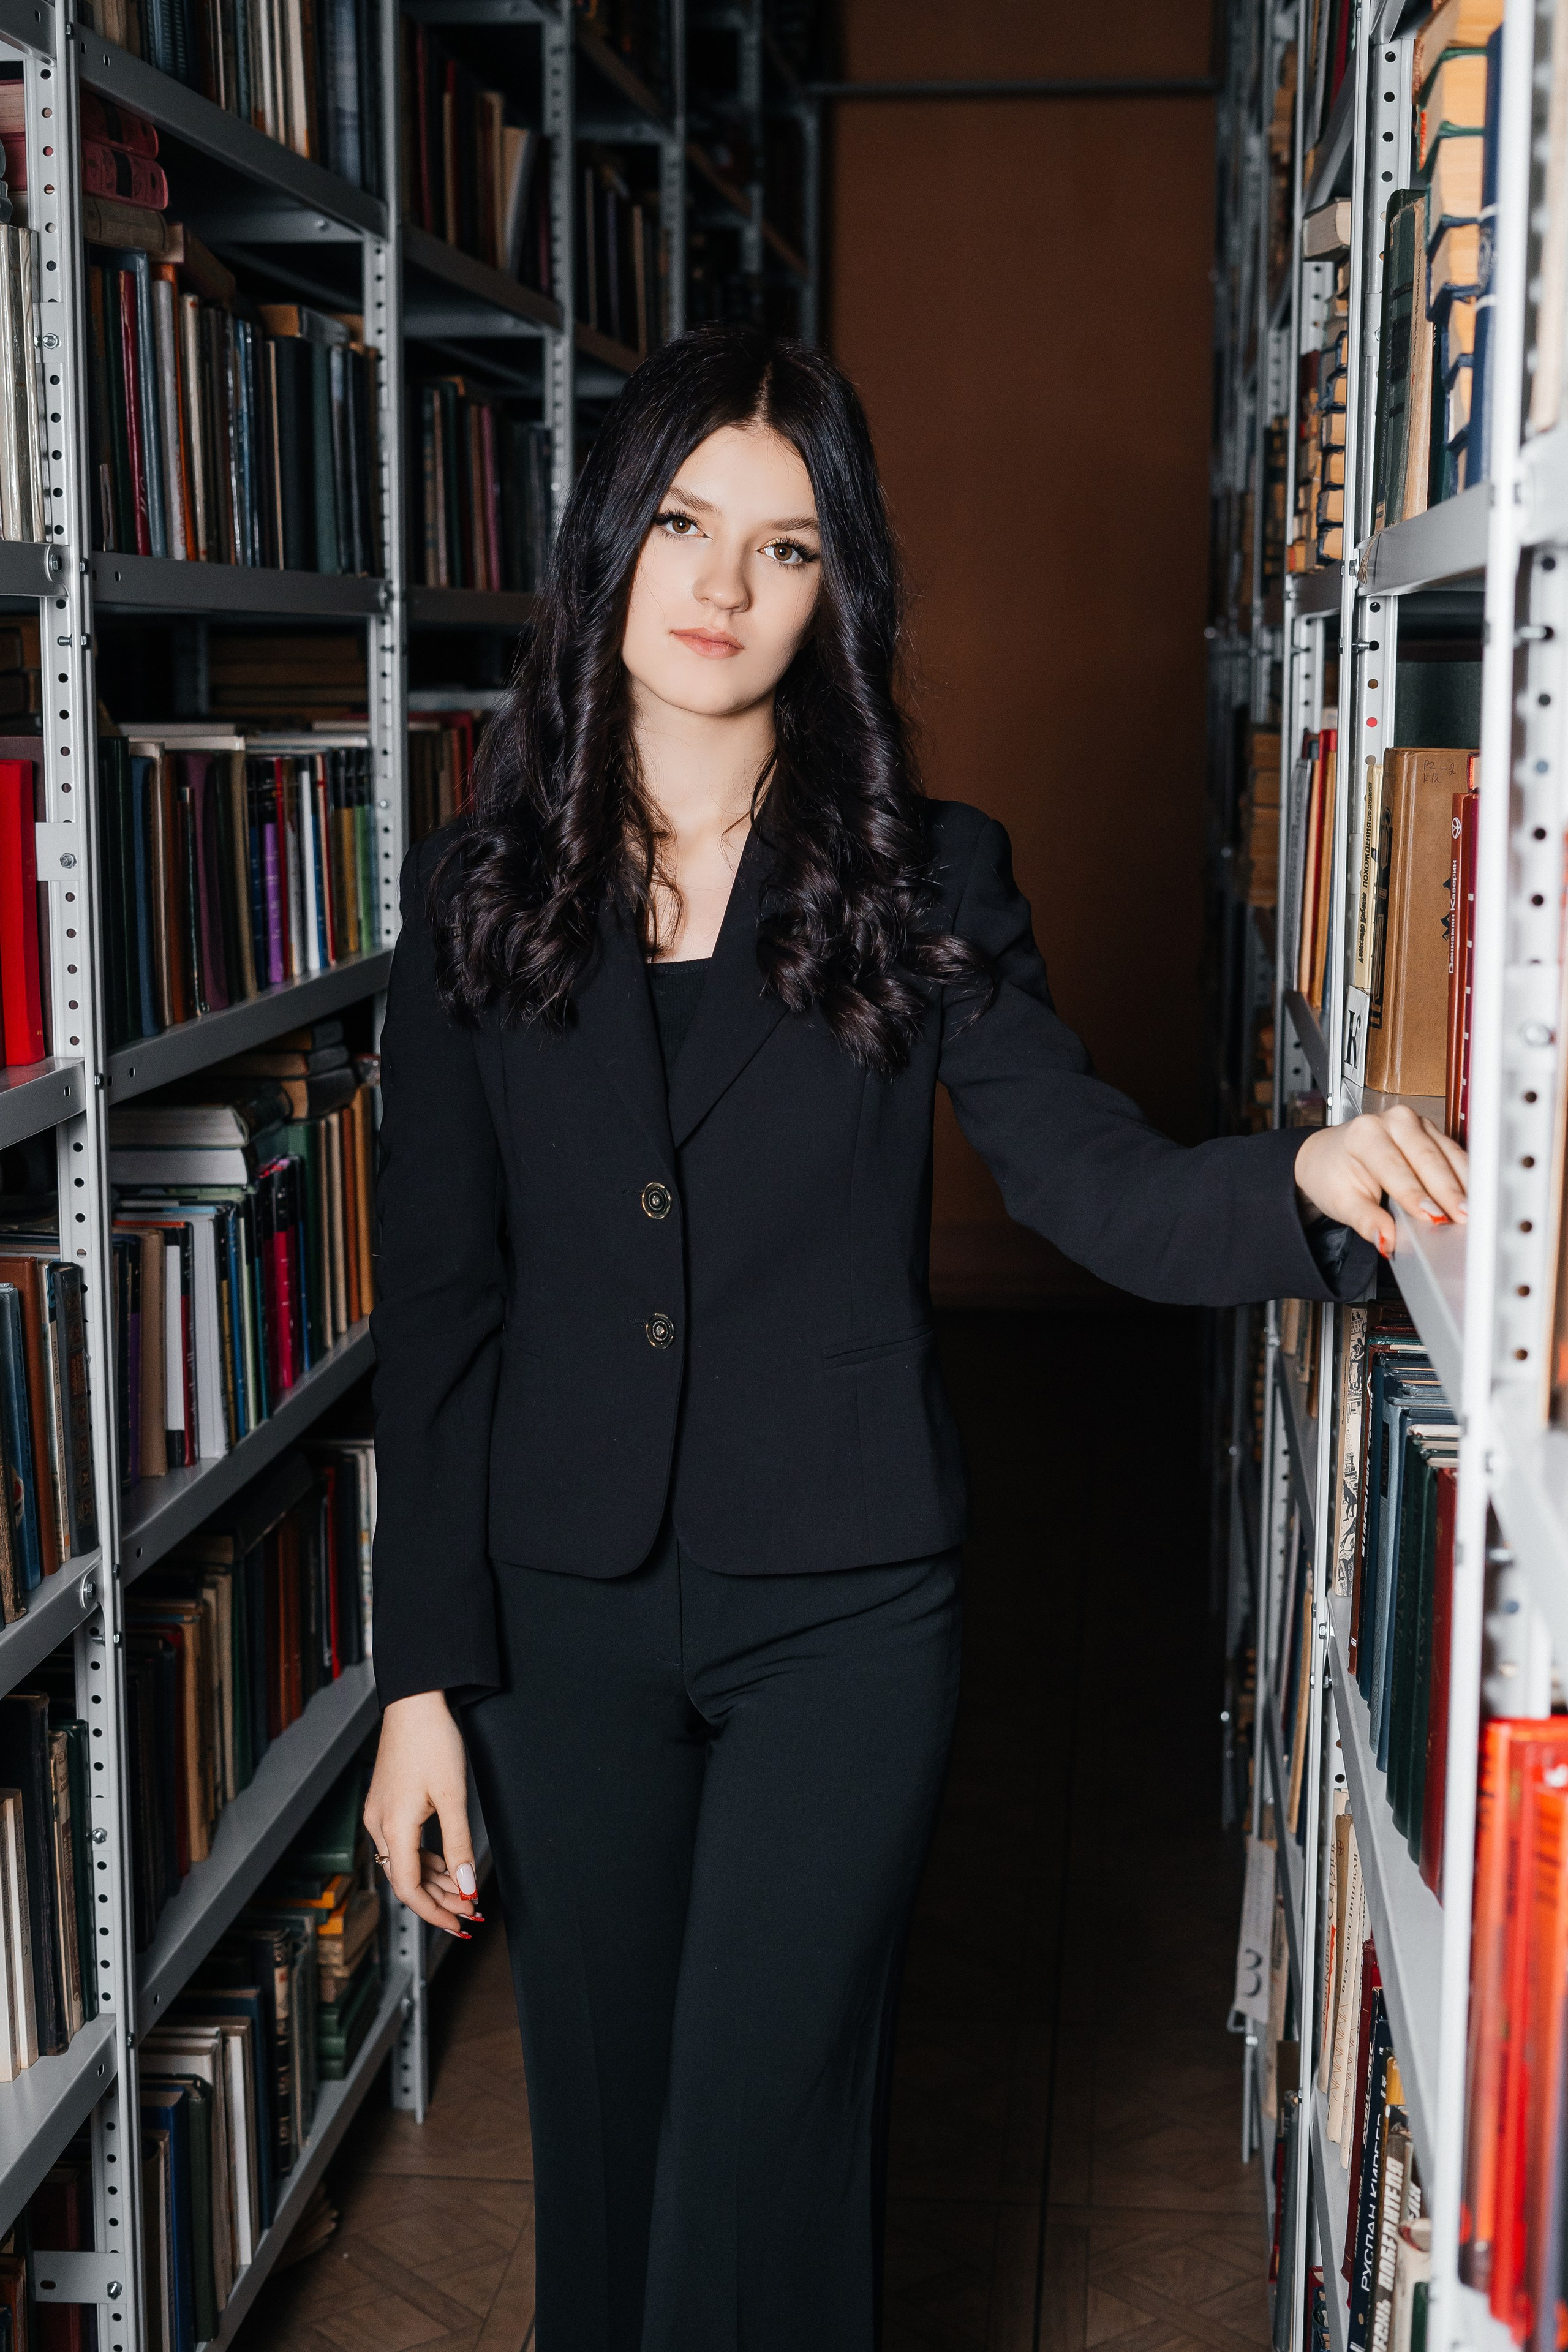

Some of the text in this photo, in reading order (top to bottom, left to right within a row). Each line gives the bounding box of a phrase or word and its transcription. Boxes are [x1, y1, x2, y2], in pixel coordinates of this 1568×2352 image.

[1363, 821, 1372, 888] ПОХОЖДЕНИЯ
[1358, 923, 1366, 964] Александр
[1346, 1853, 1358, 1950] КЕТЛИНСКАЯ
[1372, 2155, 1404, 2352] ЕСНЬ ПОБЕДИТЕЛЯ
